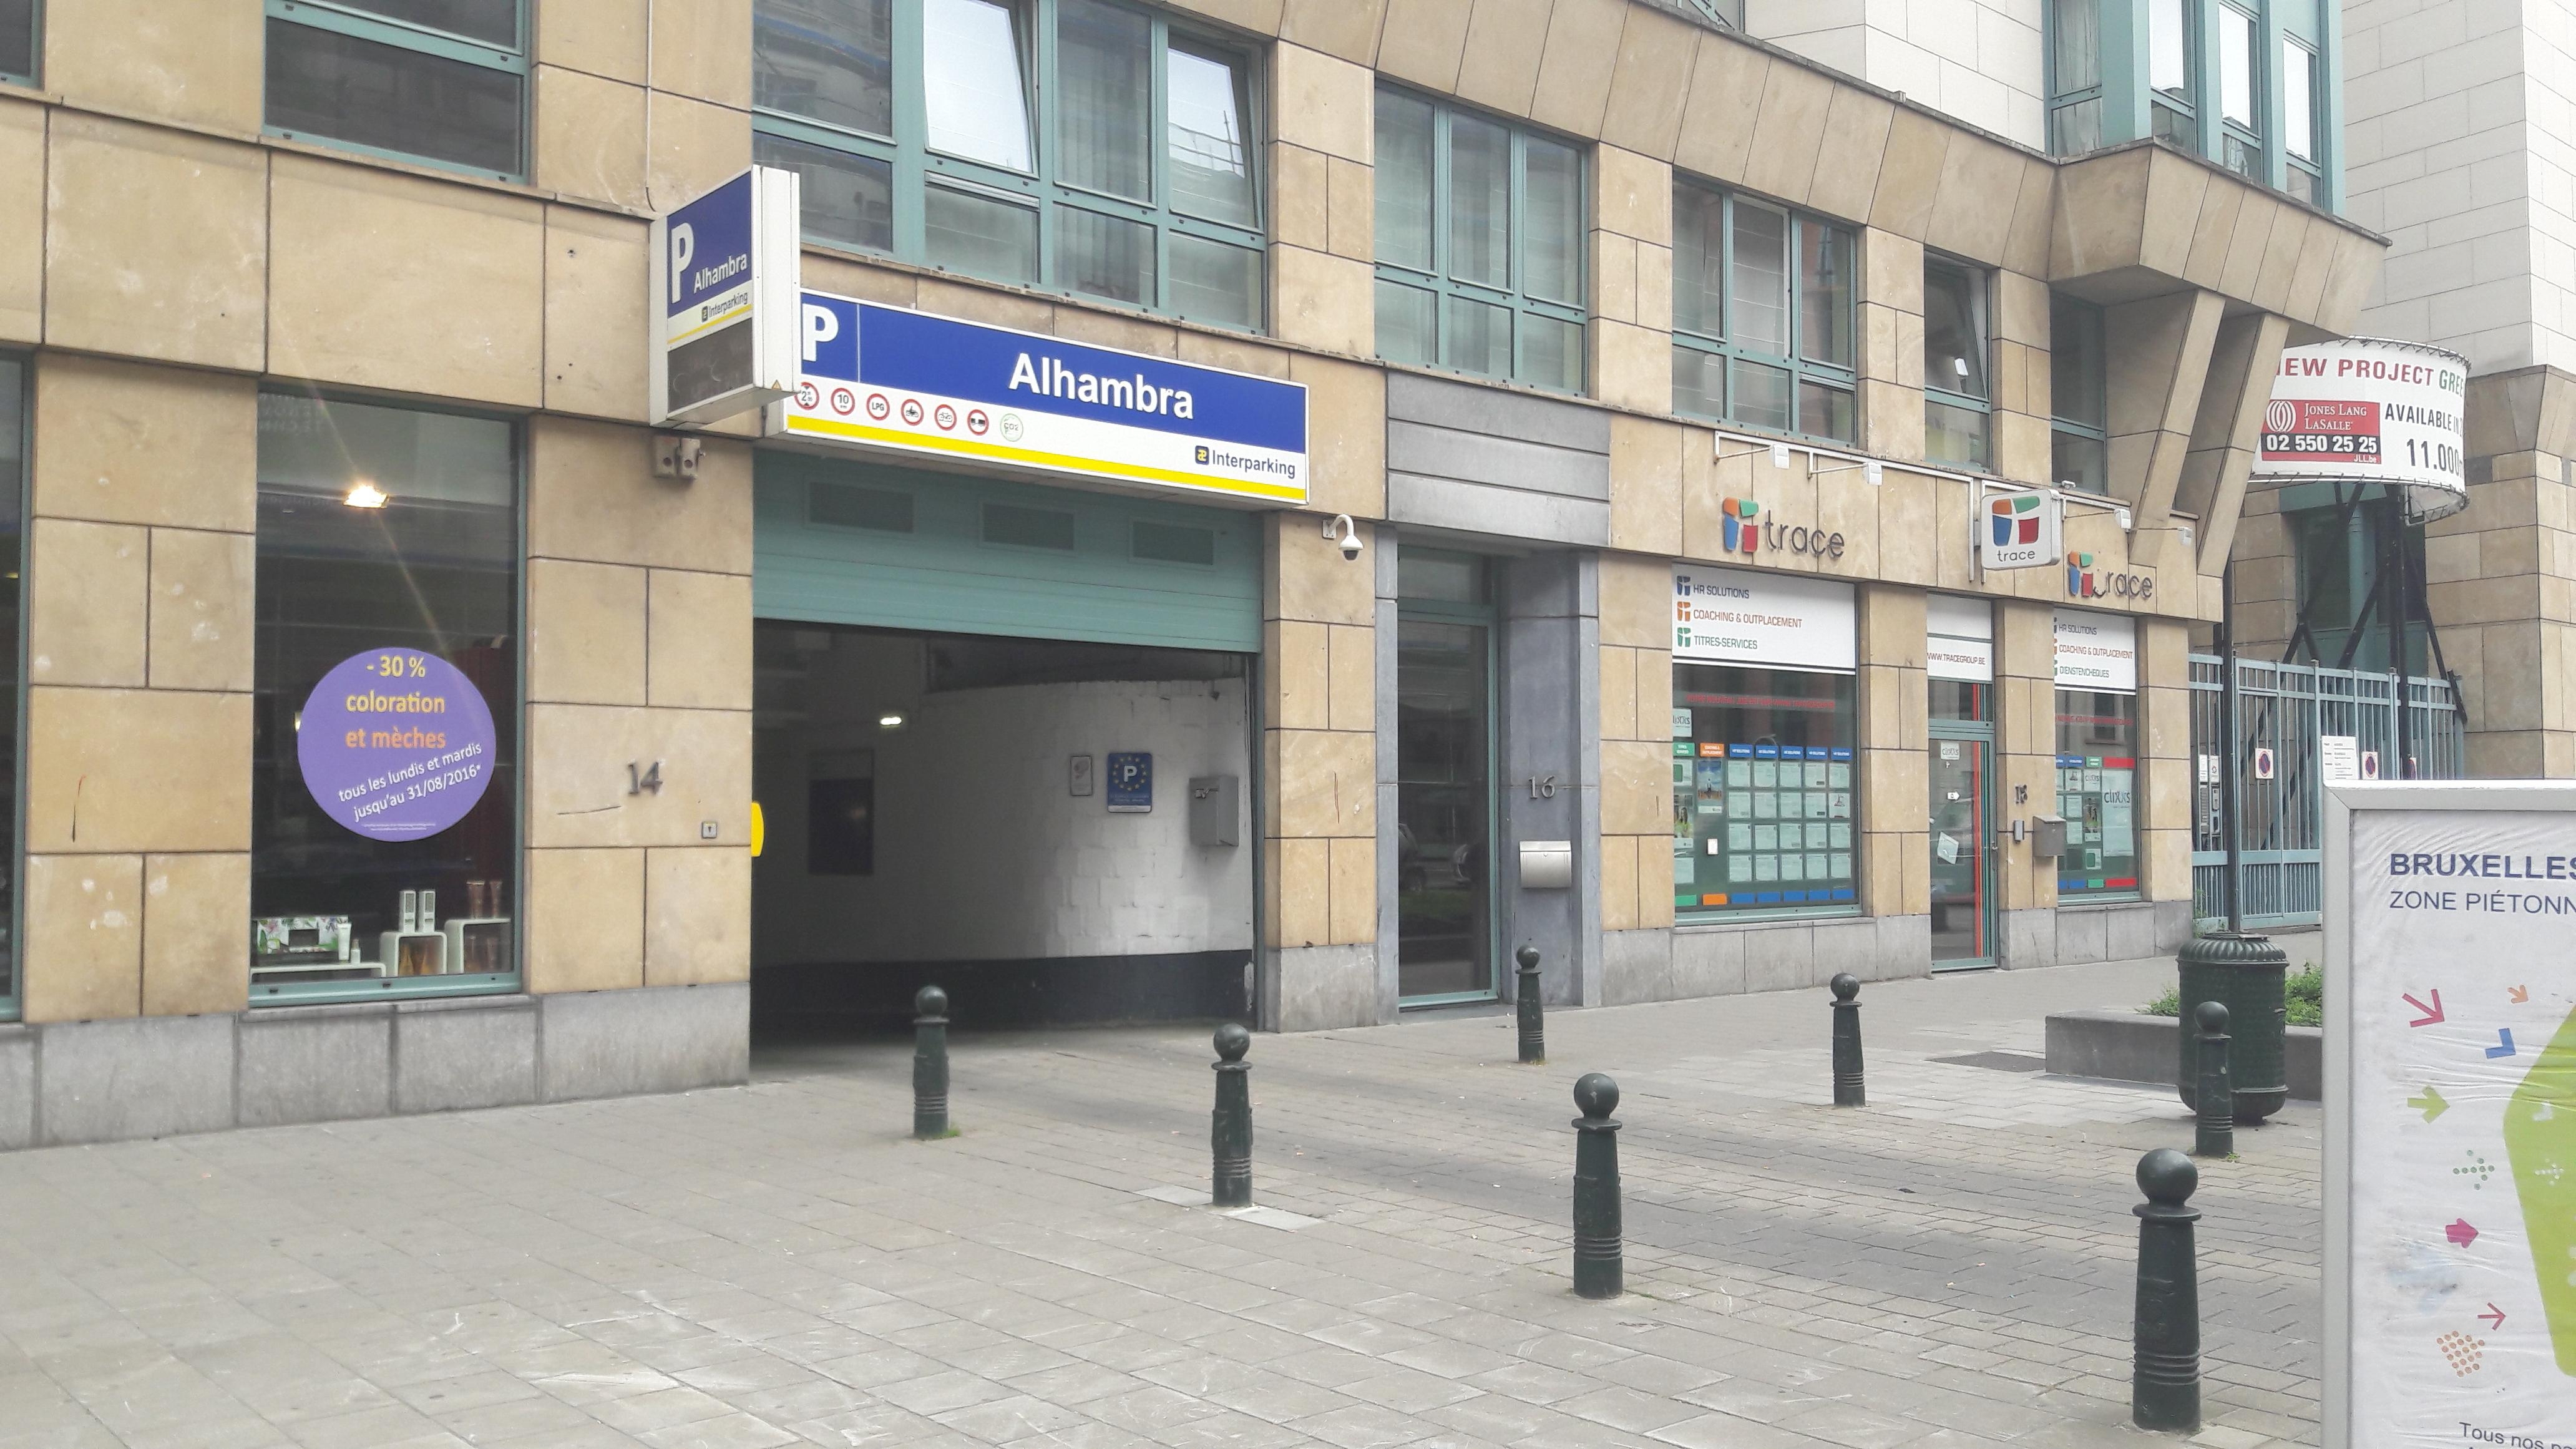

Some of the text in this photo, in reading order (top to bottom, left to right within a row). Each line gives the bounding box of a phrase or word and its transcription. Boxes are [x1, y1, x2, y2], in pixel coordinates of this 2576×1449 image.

[671, 222, 694, 304] P
[693, 253, 747, 294] Alhambra
[710, 293, 748, 317] Interparking
[803, 303, 838, 361] P
[2276, 358, 2327, 376] EW
[2338, 359, 2434, 386] PROJECT
[1008, 353, 1193, 419] Alhambra
[837, 394, 849, 404] 10
[872, 402, 885, 411] LPG
[2304, 402, 2367, 417] JONES LANG
[2384, 403, 2452, 431] AVAILABLE
[2266, 435, 2377, 454] 02 550 25 25
[1212, 450, 1295, 479] Interparking
[1765, 509, 1845, 559] trace
[1996, 550, 2036, 562] trace
[1693, 584, 1749, 599] HR SOLUTIONS
[1693, 609, 1802, 628] COACHING & OUTPLACEMENT
[2059, 624, 2097, 635] HR SOLUTIONS
[1694, 635, 1757, 650] TITRES-SERVICES
[2059, 645, 2087, 655] COACHING
[2093, 648, 2133, 659] OUTPLACEMENT
[379, 655, 404, 677] 30
[409, 656, 426, 678] %
[2060, 666, 2109, 678] DIENSTENCHEQUES
[346, 689, 445, 714] coloration
[346, 725, 446, 749] et mèches
[338, 743, 482, 802] tous les lundis et mardis
[628, 761, 663, 795] 14
[1124, 765, 1137, 782] P
[1529, 776, 1555, 799] 16
[2389, 891, 2457, 910] ZONE
[2459, 1422, 2504, 1445] Tous
